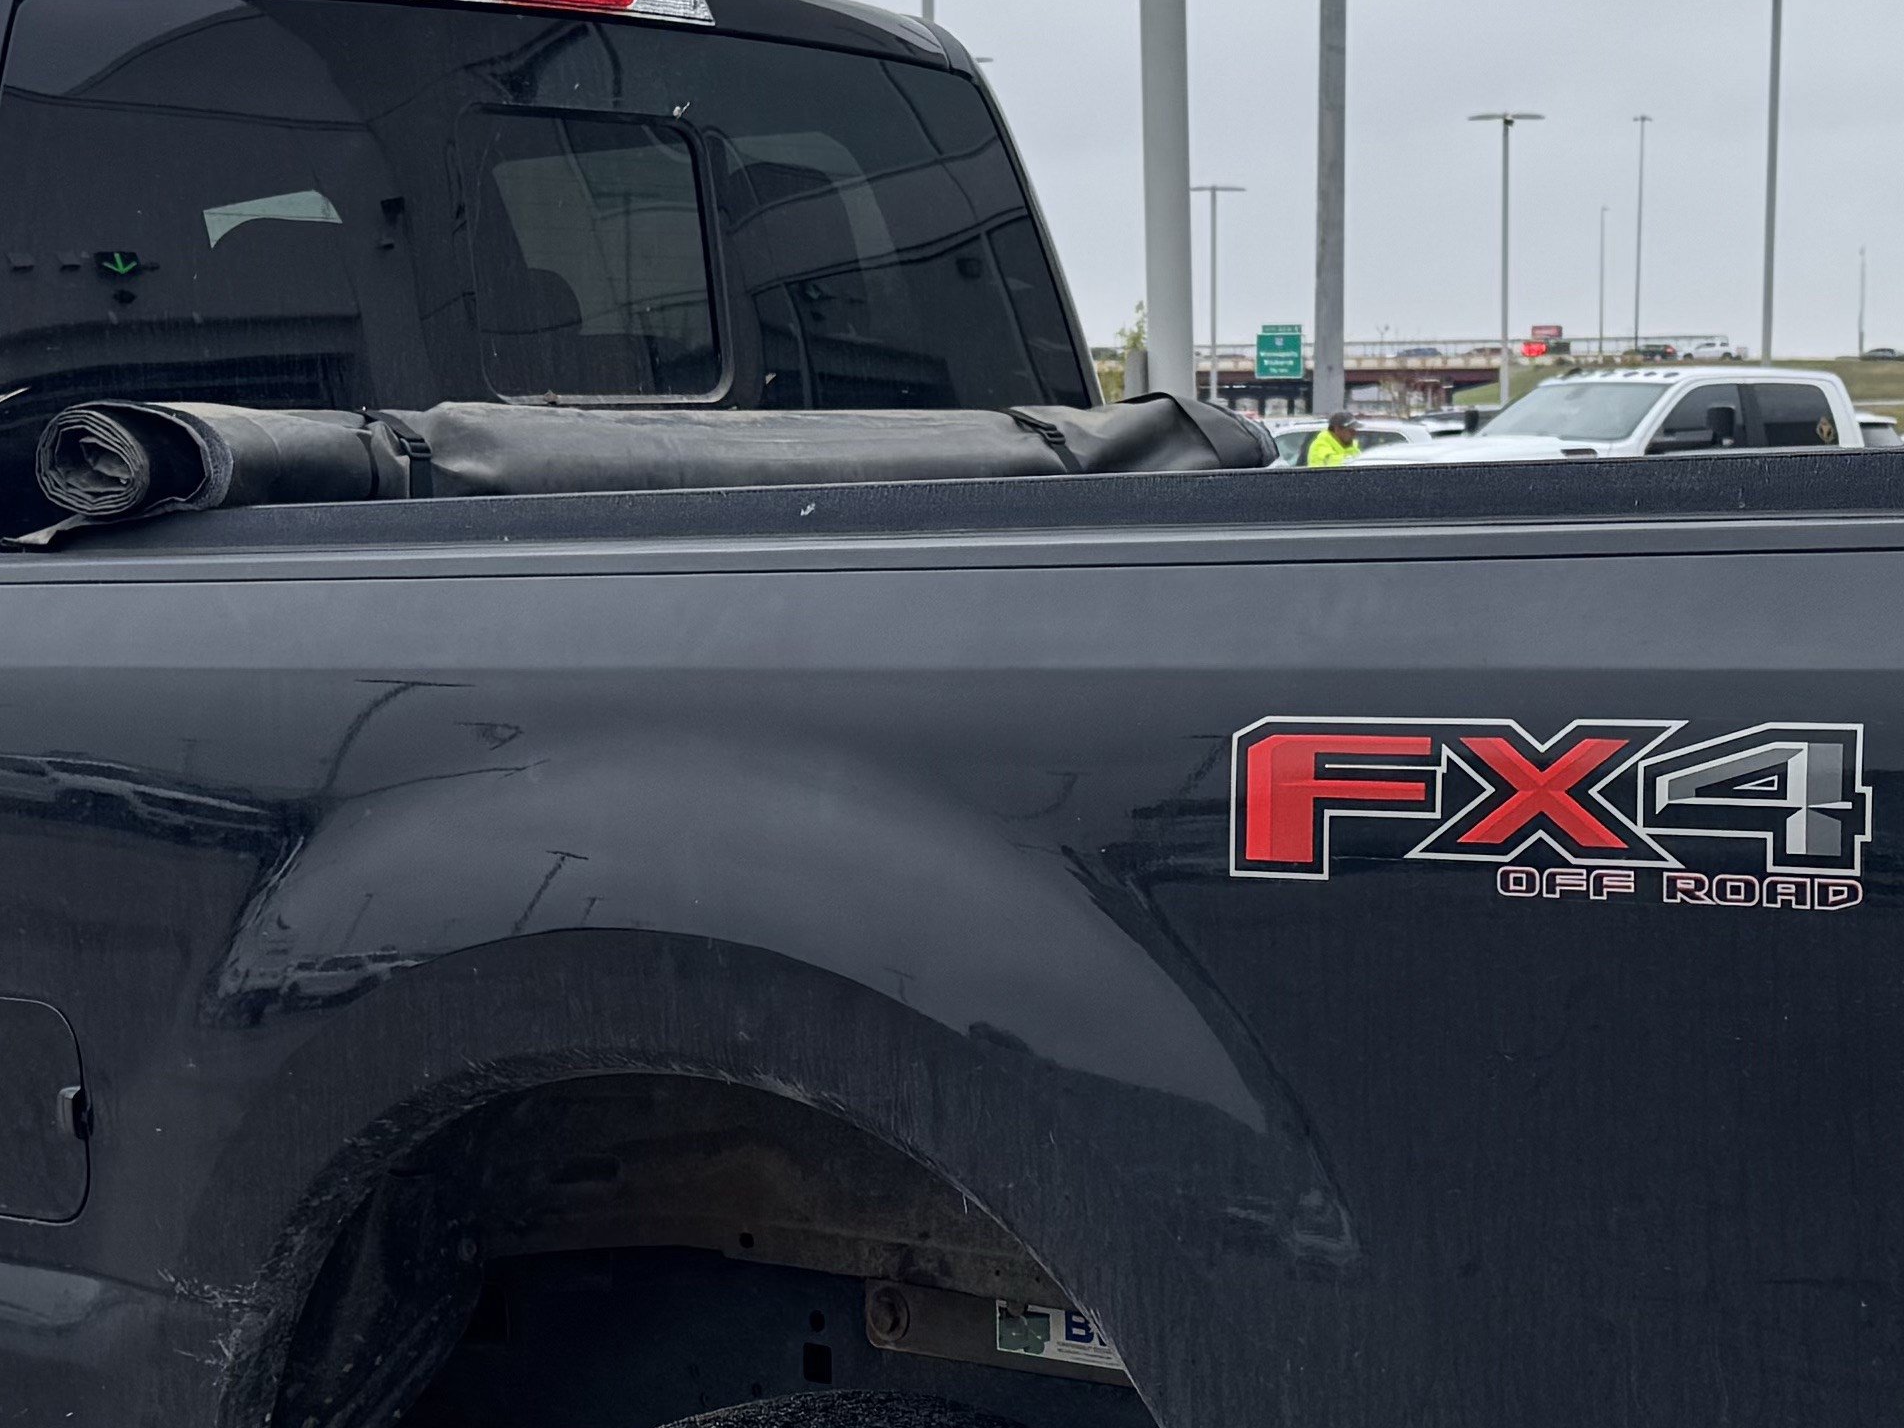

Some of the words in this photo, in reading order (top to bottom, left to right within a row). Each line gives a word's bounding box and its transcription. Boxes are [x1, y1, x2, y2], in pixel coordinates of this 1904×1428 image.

[1229, 715, 1873, 880] FX4
[1496, 865, 1636, 900] OFF
[1662, 870, 1864, 911] ROAD
